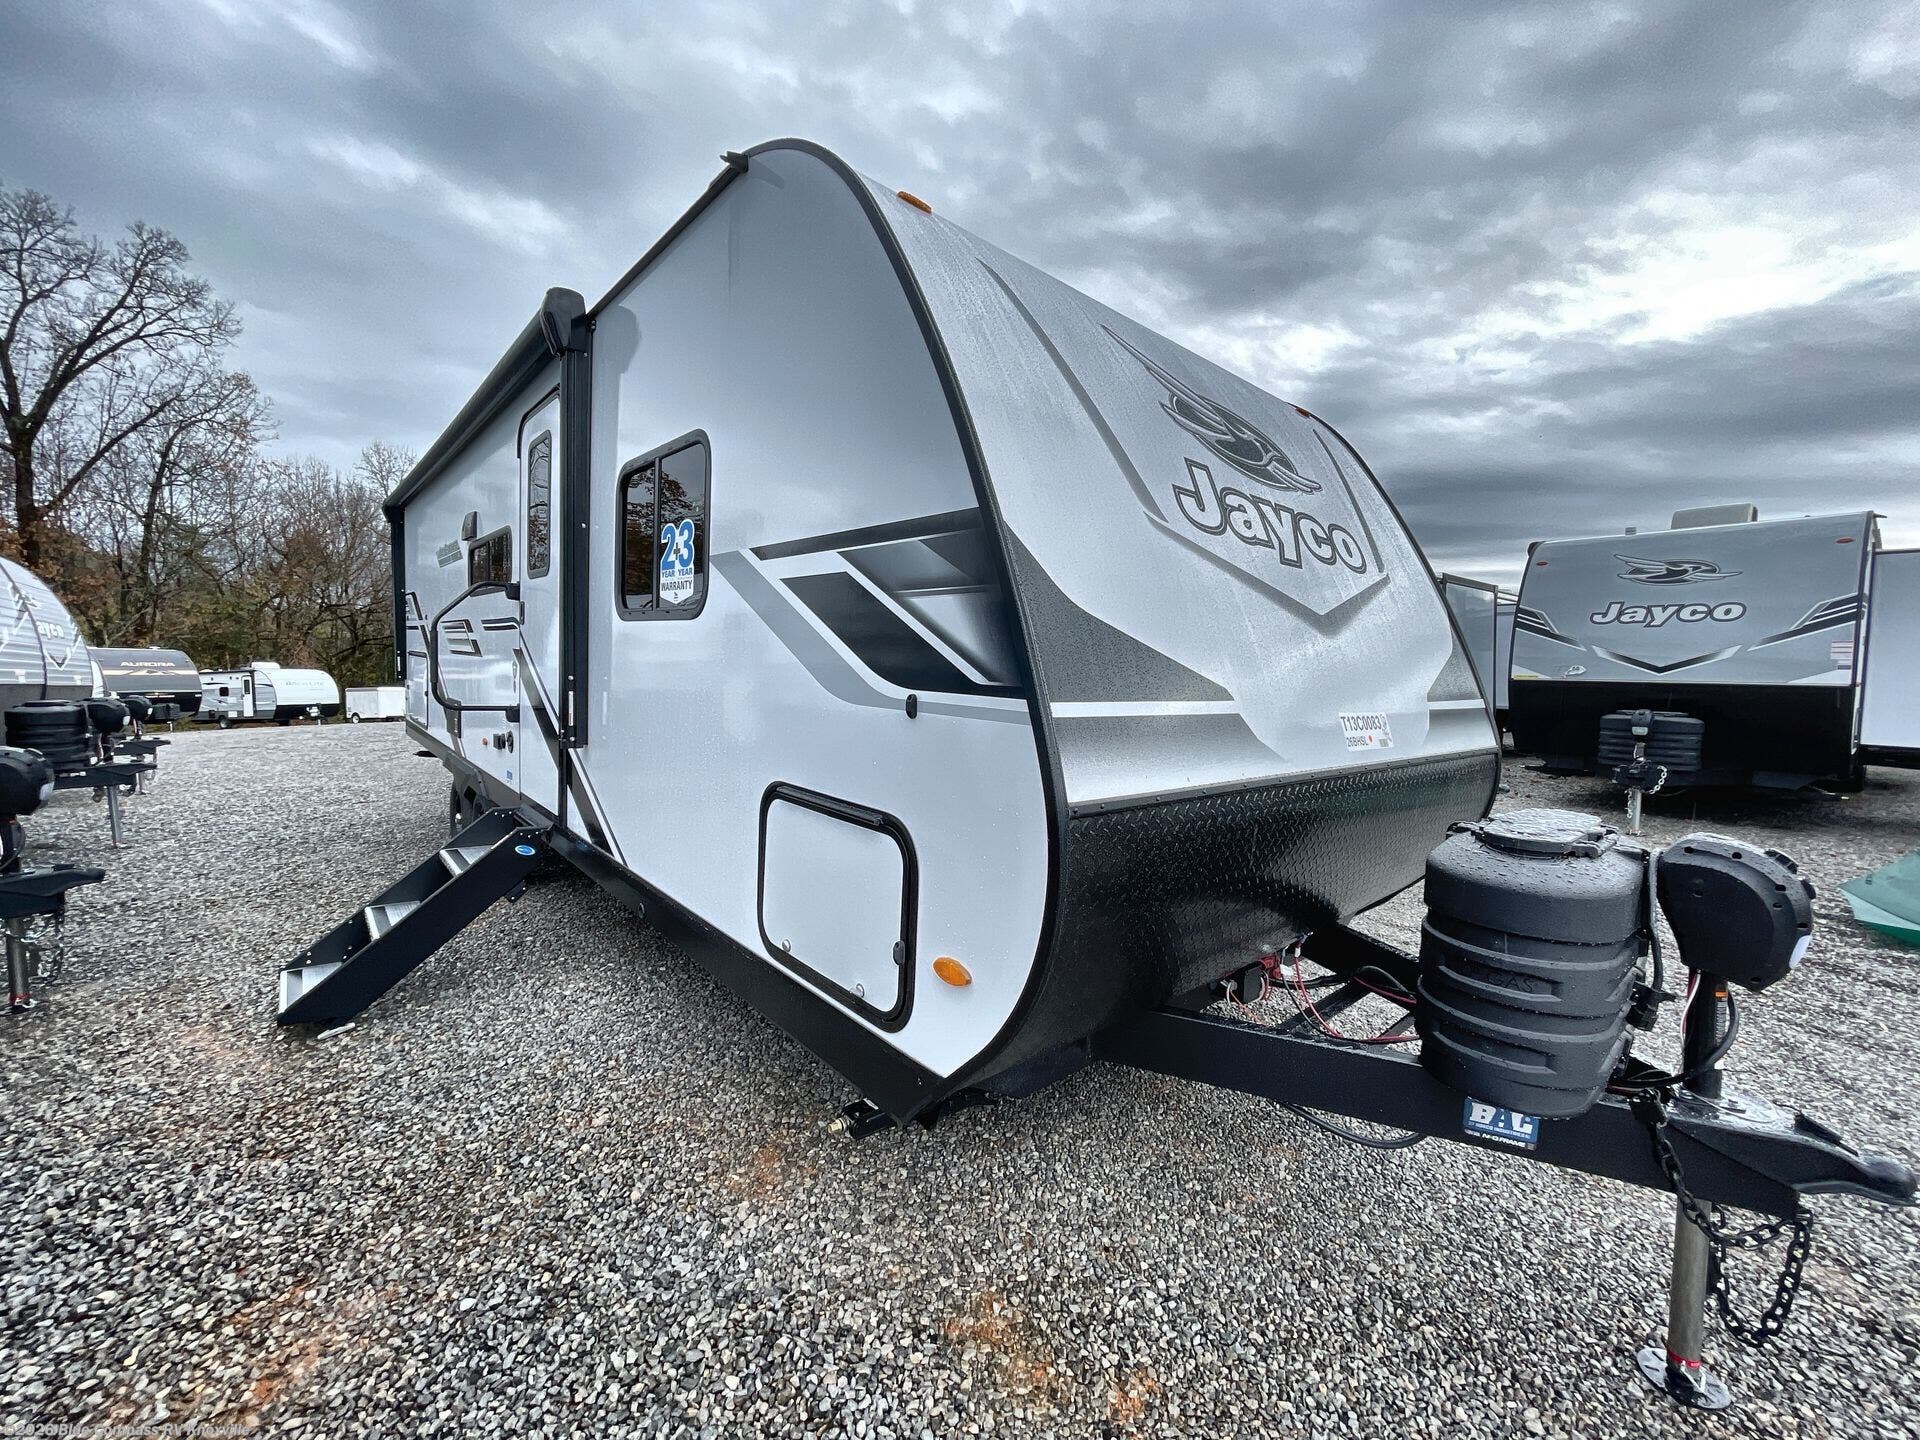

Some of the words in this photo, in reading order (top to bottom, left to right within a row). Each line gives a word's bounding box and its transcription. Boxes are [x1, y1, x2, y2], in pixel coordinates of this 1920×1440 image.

[1172, 457, 1367, 574] Jayco
[661, 570, 676, 578] YEAR
[677, 568, 693, 576] YEAR
[660, 580, 693, 592] WARRANTY
[1589, 601, 1747, 628] Jayco
[1341, 716, 1382, 731] T13C0083
[1469, 1101, 1533, 1134] BAL
